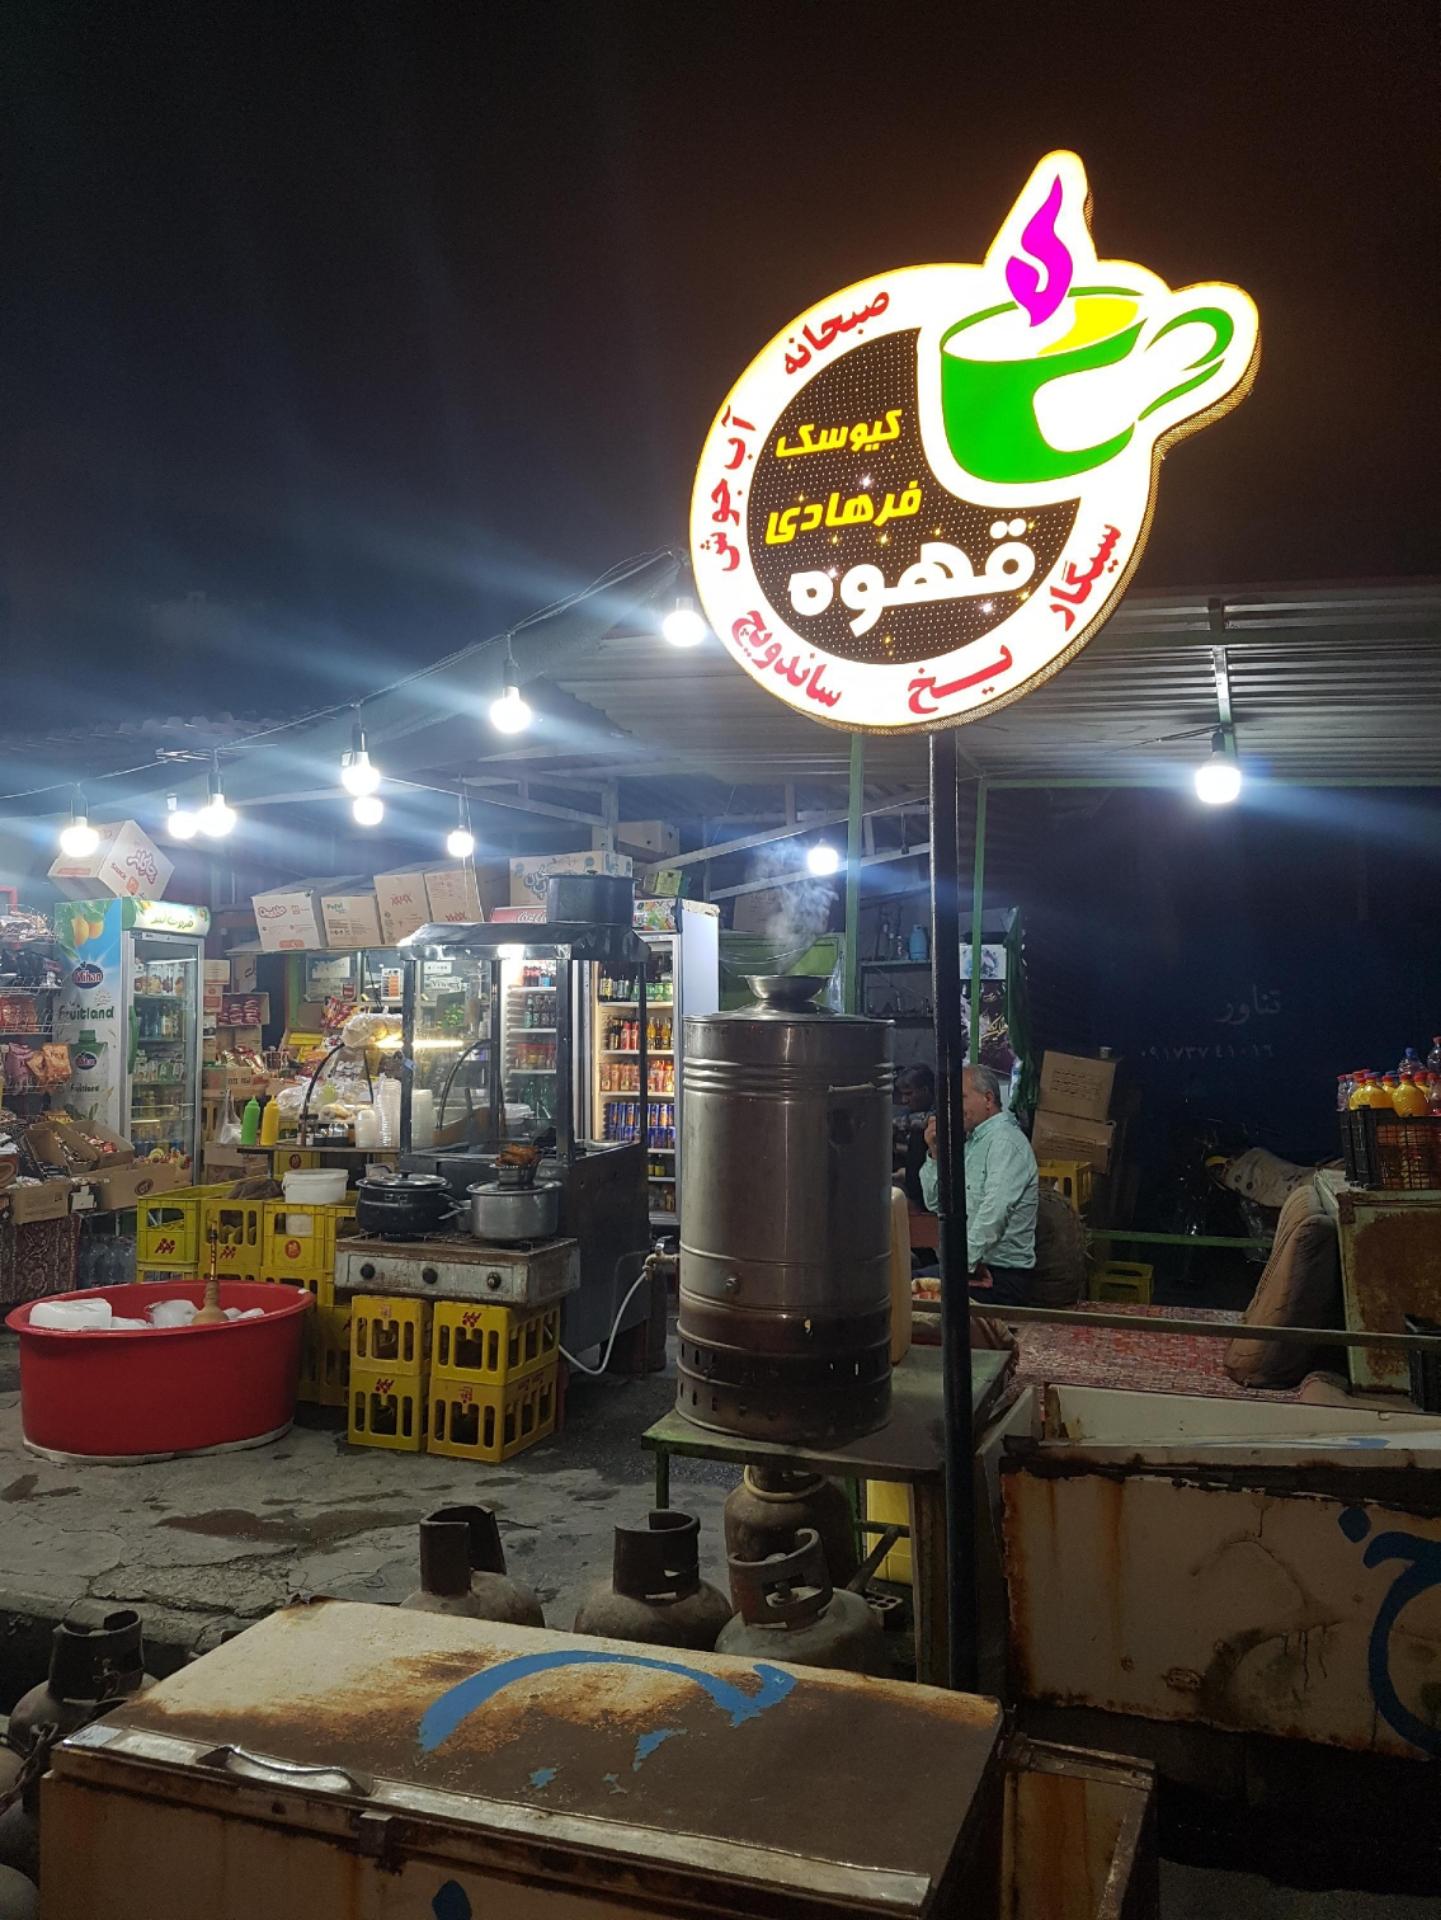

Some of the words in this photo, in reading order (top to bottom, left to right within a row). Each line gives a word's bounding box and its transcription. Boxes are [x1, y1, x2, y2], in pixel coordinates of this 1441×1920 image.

[783, 291, 890, 375] صبحانه
[775, 409, 902, 458] کیوسک
[700, 478, 743, 571] جوش
[765, 480, 922, 545] فرهادی
[788, 518, 1036, 638] قهوه
[1049, 525, 1122, 632] سیگار
[731, 609, 843, 708] ساندویچ
